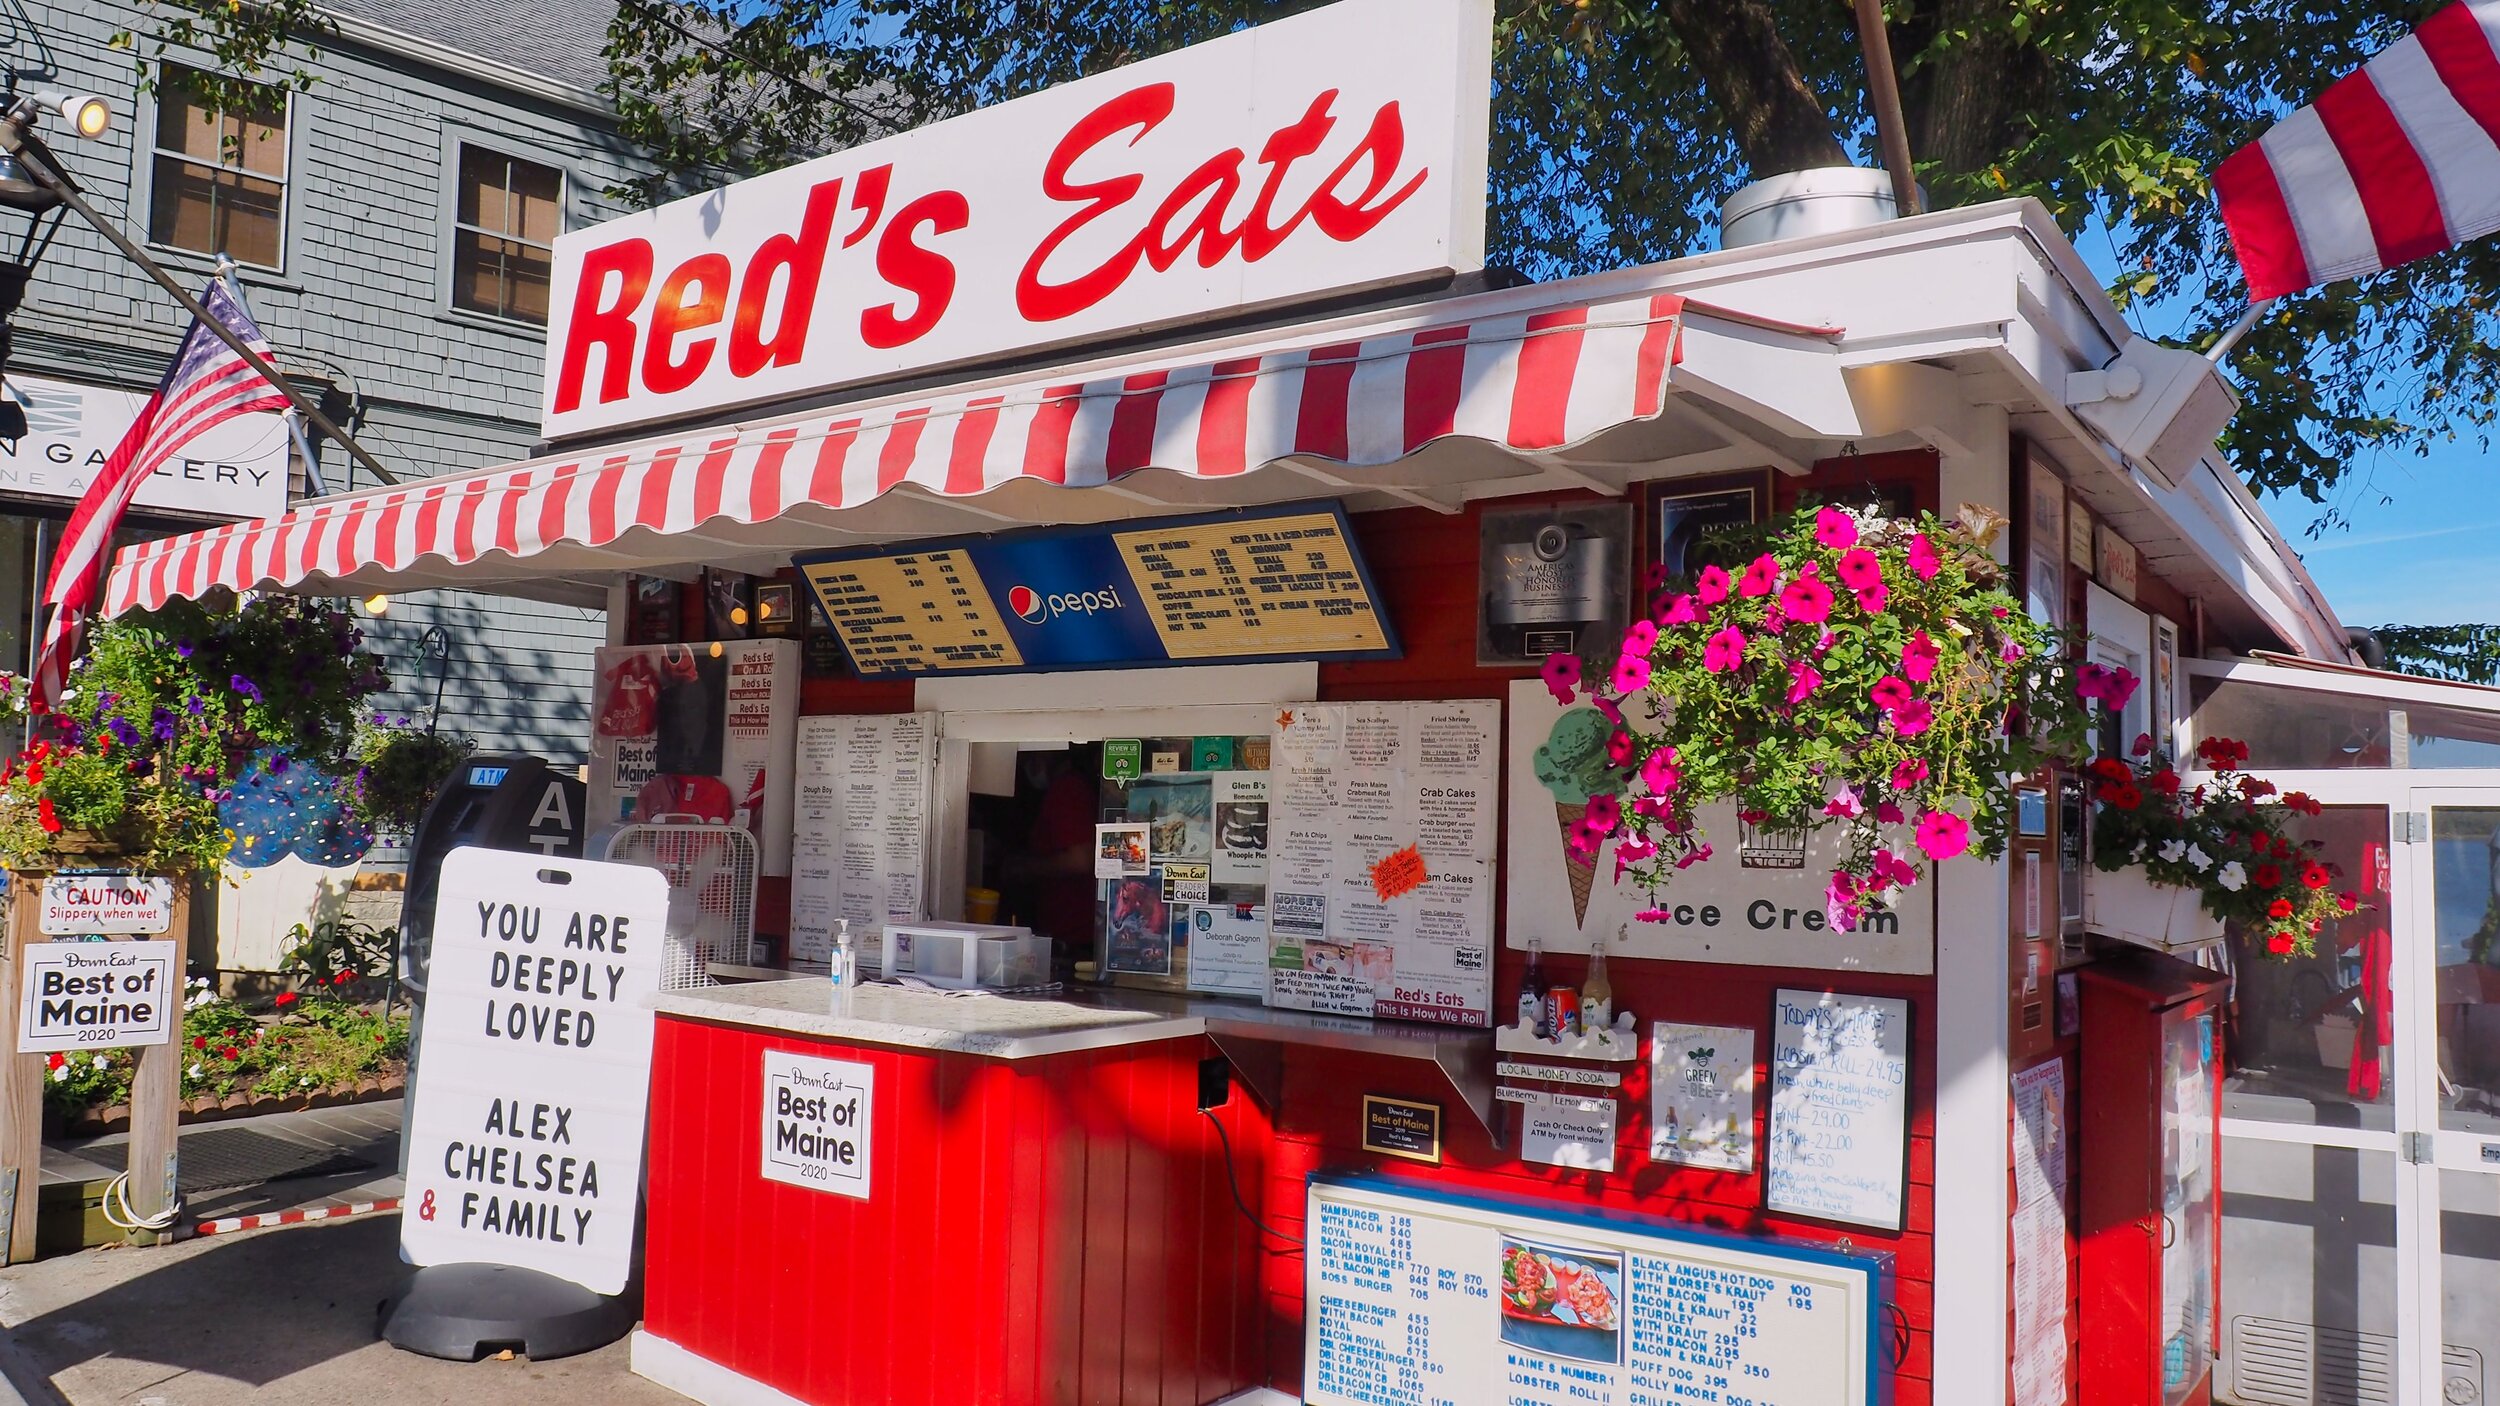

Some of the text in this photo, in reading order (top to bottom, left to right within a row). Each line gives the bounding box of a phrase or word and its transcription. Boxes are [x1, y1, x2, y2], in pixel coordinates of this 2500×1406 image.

[551, 81, 1429, 415] Red's Eats
[46, 443, 270, 487] GALERY
[1253, 532, 1272, 543] TEA
[1246, 542, 1293, 554] LEMONADE
[1048, 584, 1122, 618] pepsi
[1190, 621, 1207, 631] TEA
[618, 744, 658, 762] Best of
[477, 766, 507, 785] ATM
[617, 763, 657, 782] Maine
[1231, 781, 1266, 790] Glen B's
[1347, 789, 1391, 797] Crabmeat Roll
[1420, 787, 1476, 798] Crab Cakes
[1233, 793, 1264, 801] Homemade
[1419, 819, 1435, 827] Crab
[1310, 832, 1328, 840] Chips
[1374, 834, 1393, 842] Clams
[1227, 851, 1267, 860] Whoopie Pies
[1165, 865, 1207, 880] Down East
[1444, 873, 1474, 884] Cakes
[66, 888, 148, 906] CAUTION
[1175, 890, 1207, 901] CHOICE
[1275, 895, 1324, 906] MORSE'S
[49, 906, 158, 922] Slippery when wet
[1747, 899, 1899, 935] Crem
[477, 900, 630, 954] YOU ARE
[1205, 932, 1261, 943] Deborah Gagnon
[65, 951, 139, 968] Down East
[1456, 950, 1473, 960] Best
[1456, 957, 1482, 969] Maine
[42, 968, 156, 996] Best of
[490, 951, 625, 1002] DEEPLY
[1394, 987, 1465, 1007] Red's Eats
[40, 996, 153, 1027] Maine
[1376, 1003, 1483, 1025] This Is How We Roll
[485, 999, 595, 1048] LOVED
[78, 1028, 116, 1042] 2020
[792, 1067, 843, 1092] Down East
[1500, 1064, 1605, 1084] LOCAL HONEY SODA
[1685, 1069, 1718, 1084] GREEN
[777, 1086, 857, 1128] Best of
[485, 1097, 572, 1146] ALEX
[1371, 1113, 1430, 1131] Best of Maine
[1533, 1120, 1604, 1136] Cash Or Check Only
[776, 1119, 855, 1166] Maine
[1530, 1129, 1604, 1144] ATM by front window
[444, 1141, 599, 1199] CHELSEA
[800, 1162, 828, 1181] 2020
[418, 1189, 593, 1246] & FAMILY
[1321, 1203, 1380, 1222] HAMBURGER
[1321, 1214, 1411, 1239] WITH BACON 540
[1321, 1225, 1411, 1250] ROYAL 485
[1321, 1236, 1411, 1261] BACON ROYAL 615
[1632, 1256, 1670, 1272] BLACK
[1676, 1264, 1716, 1281] ANGUS
[1720, 1272, 1745, 1286] HOT
[1749, 1277, 1775, 1291] DOG
[1321, 1271, 1429, 1300] BOSS BURGER 705
[1632, 1269, 1767, 1302] WITH MORSE'S KRAUT
[1319, 1295, 1429, 1326] CHEESEBURGER 455
[1632, 1305, 1694, 1325] STURDLEY
[1631, 1359, 1728, 1389] PUFF DOG 395
[1508, 1372, 1598, 1401] LOBSTER ROLL
[1631, 1375, 1718, 1402] HOLLY MOORE
